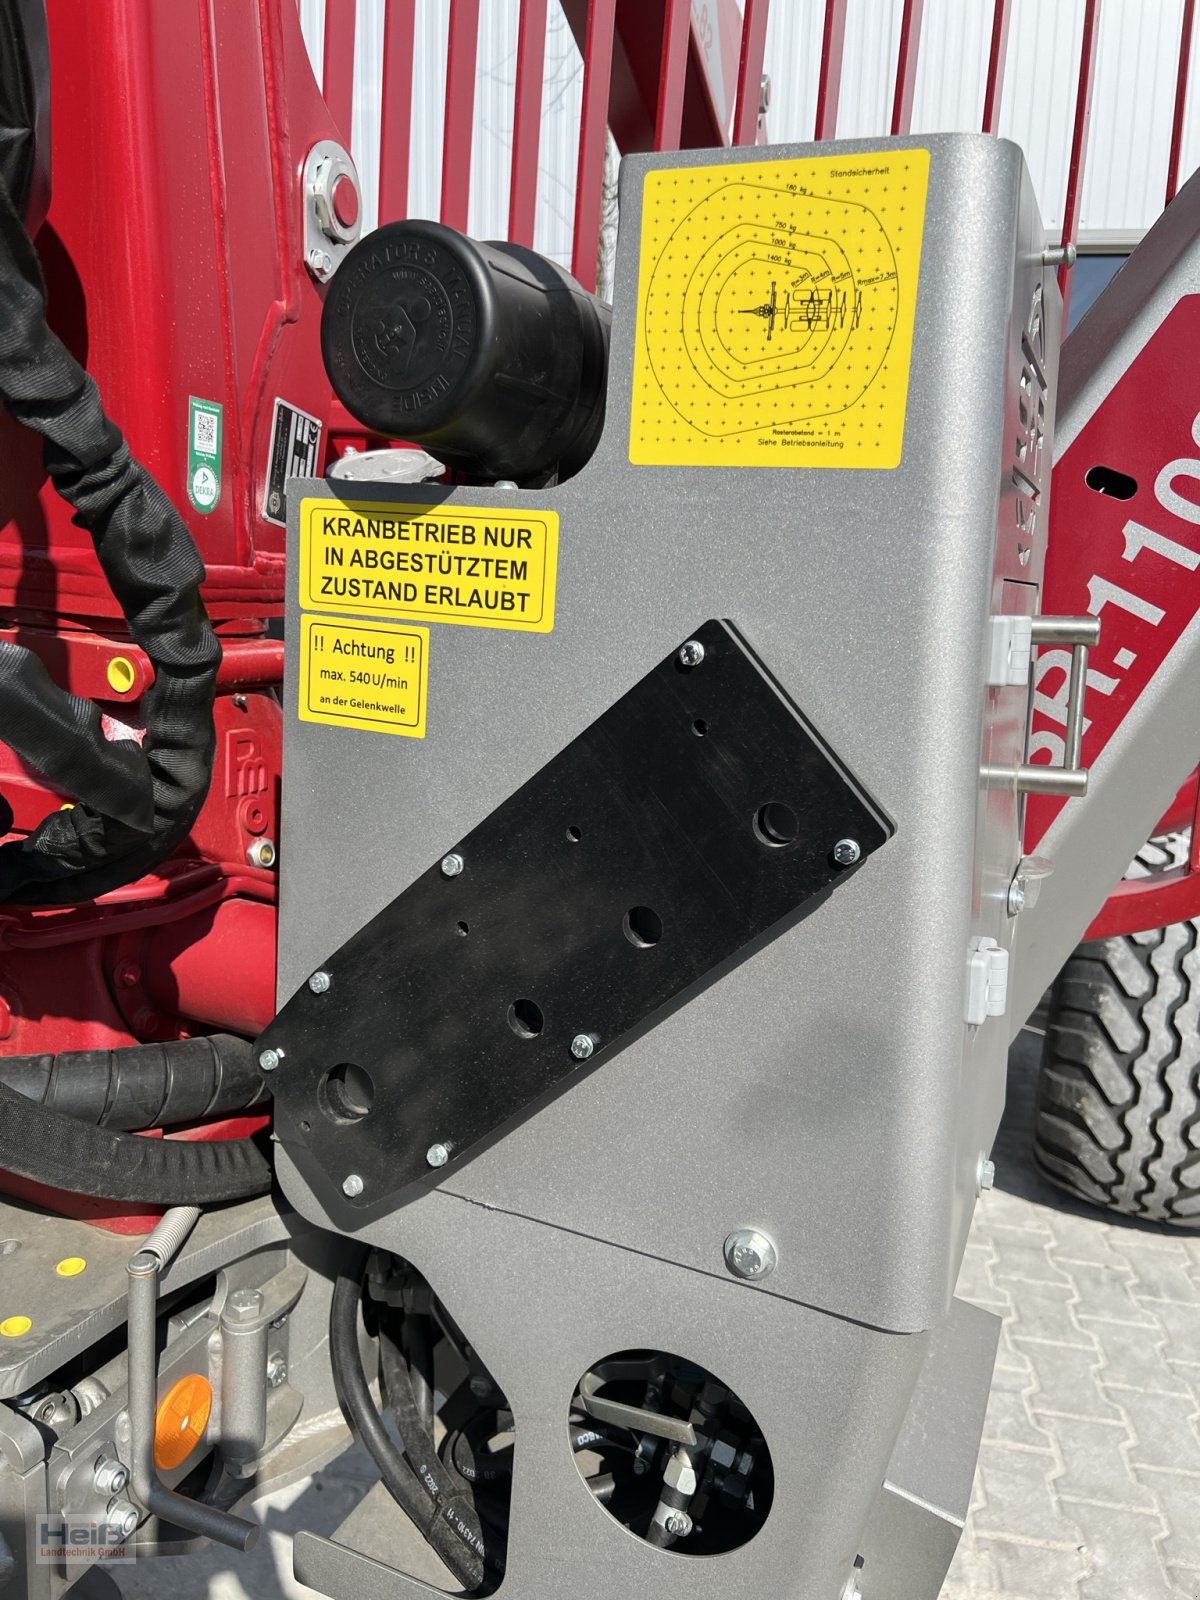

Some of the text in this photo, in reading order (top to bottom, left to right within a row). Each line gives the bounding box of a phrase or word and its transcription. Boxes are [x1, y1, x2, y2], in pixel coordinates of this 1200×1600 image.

[830, 167, 890, 178] Standsicherheit
[799, 186, 807, 194] kg
[775, 221, 797, 233] 750 kg
[772, 238, 796, 250] 1000 kg
[767, 254, 792, 266] 1400 kg
[782, 440, 844, 449] Betriebsanleitung
[195, 485, 214, 496] DEKRA
[322, 516, 532, 549] KRANBETRIEB NUR
[325, 547, 528, 580] IN ABGESTÜTZTEM
[320, 576, 530, 612] ZUSTAND ERLAUBT
[332, 638, 395, 664] Achtung
[320, 669, 346, 682] max.
[320, 695, 406, 715] an der Gelenkwelle
[424, 1473, 439, 1495] 2022
